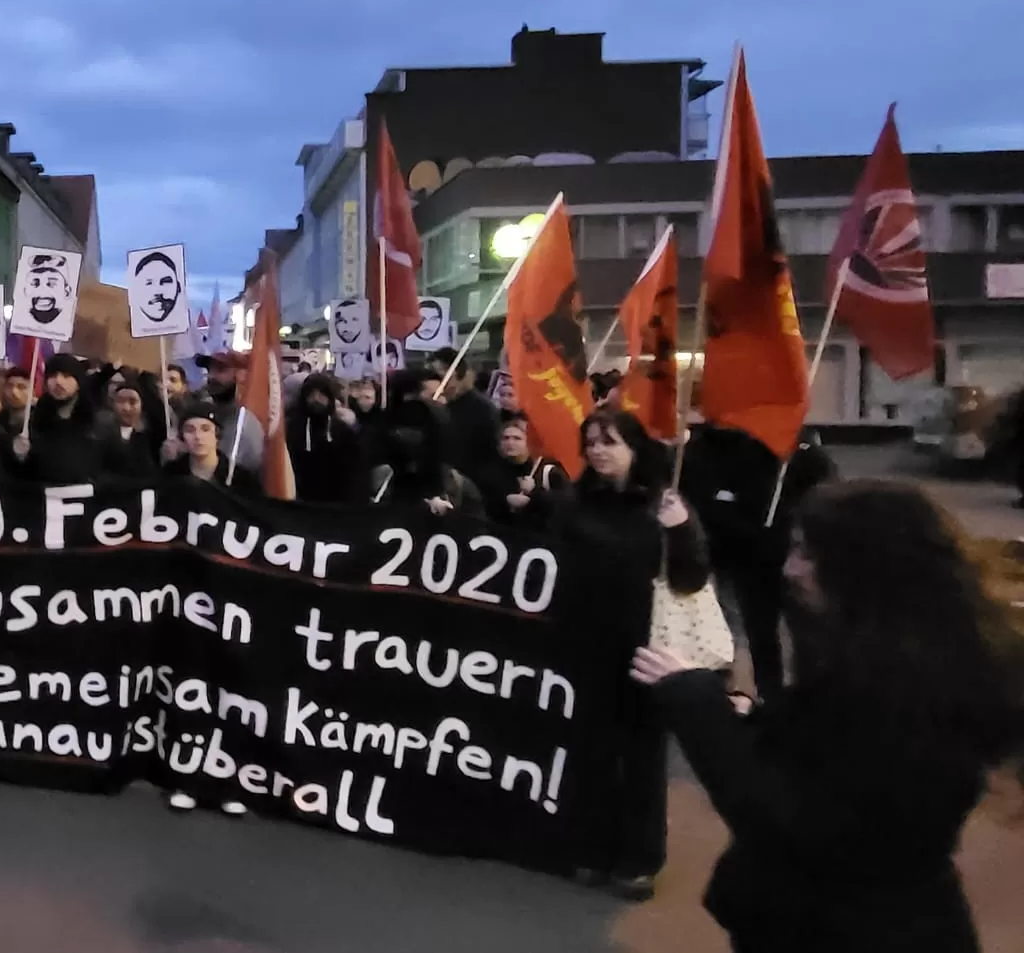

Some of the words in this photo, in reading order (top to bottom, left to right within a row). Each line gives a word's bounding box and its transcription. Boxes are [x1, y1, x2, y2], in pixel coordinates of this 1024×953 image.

[44, 483, 351, 579] Februar
[371, 527, 559, 614] 2020
[293, 606, 576, 720] trauern
[120, 708, 167, 761] ist
[168, 727, 395, 835] überall
